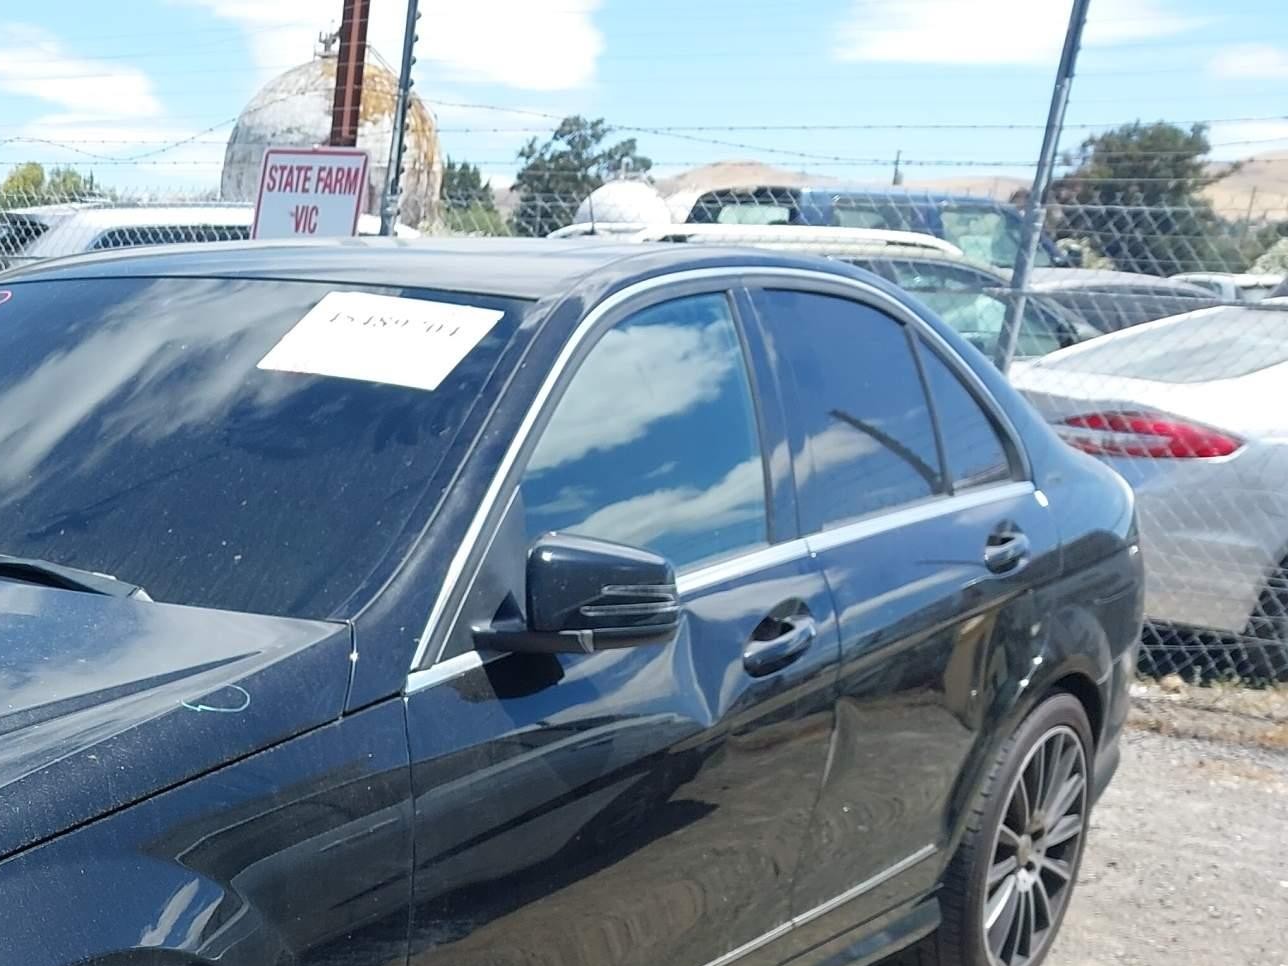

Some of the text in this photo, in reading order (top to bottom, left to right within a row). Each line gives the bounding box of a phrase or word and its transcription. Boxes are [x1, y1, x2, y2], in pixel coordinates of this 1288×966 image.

[266, 165, 360, 195] STATE FARM
[293, 205, 319, 234] VIC
